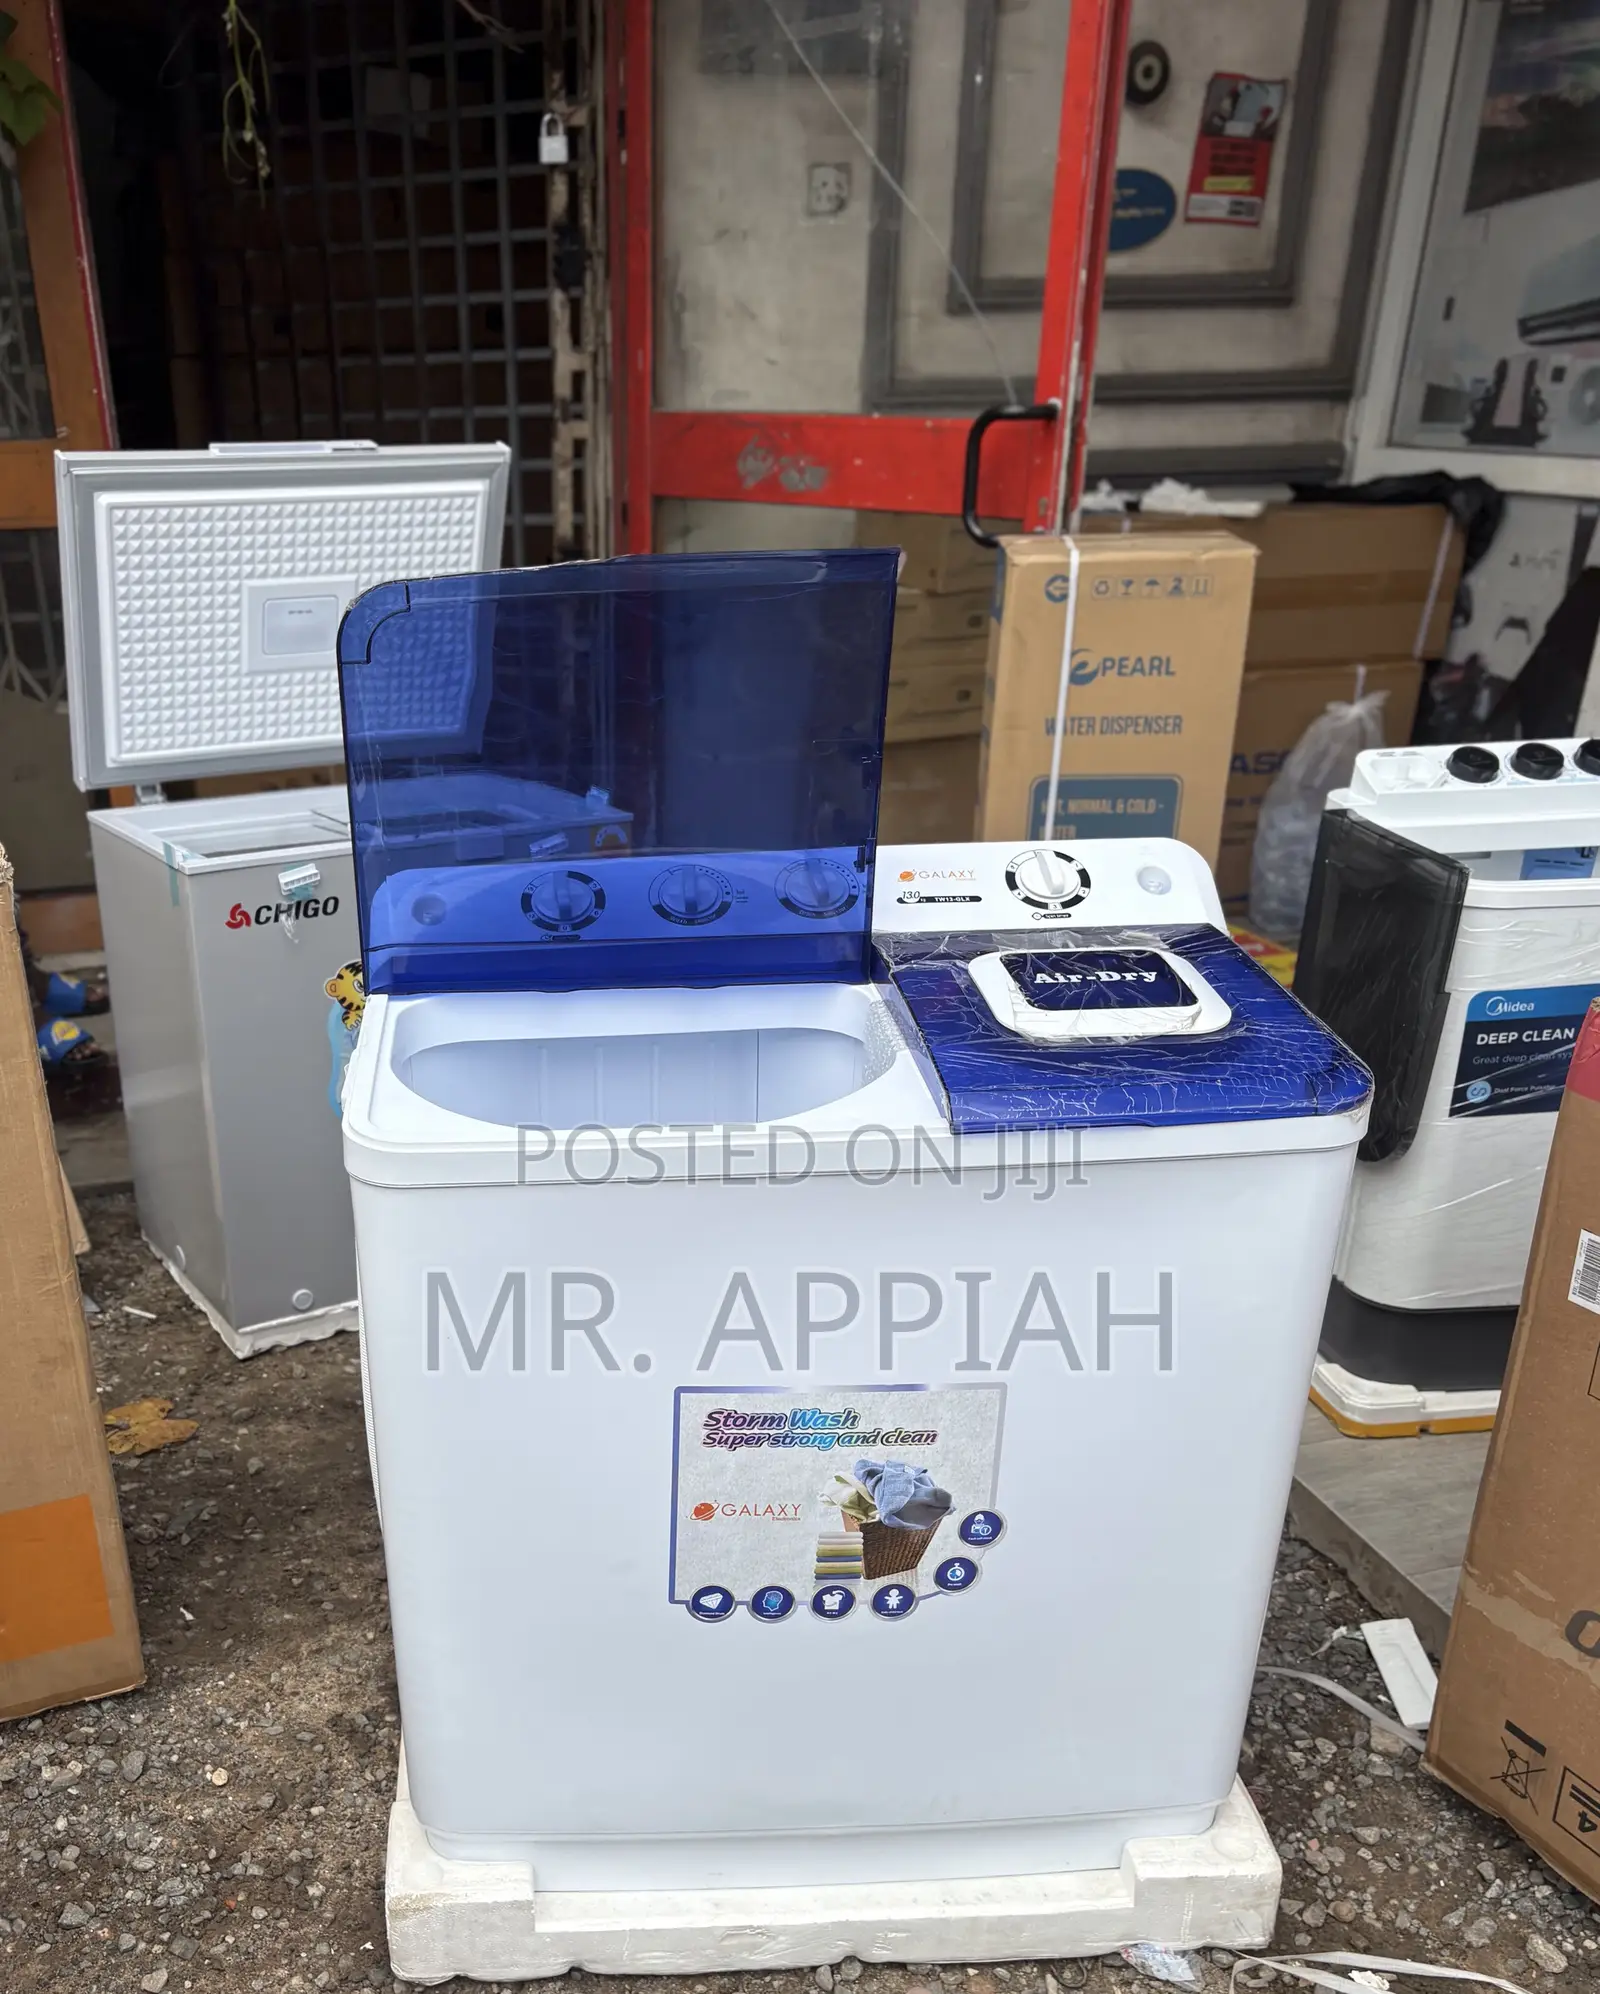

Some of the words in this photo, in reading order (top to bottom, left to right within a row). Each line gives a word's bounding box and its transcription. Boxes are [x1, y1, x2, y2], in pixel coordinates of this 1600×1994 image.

[1101, 656, 1176, 677] PEARL
[1099, 714, 1183, 735] DISPENSER
[918, 869, 975, 880] GALAXY
[902, 890, 921, 900] 13.0
[254, 896, 341, 927] CHIGO
[1034, 971, 1158, 984] Air-Dry
[1487, 997, 1535, 1016] Midea
[1476, 1031, 1519, 1046] DEEP
[1522, 1027, 1575, 1043] CLEAN
[1472, 1055, 1500, 1066] Great
[1502, 1054, 1528, 1064] deep
[703, 1409, 787, 1430] Storm
[788, 1408, 860, 1430] Wash
[702, 1430, 769, 1450] Super
[768, 1431, 838, 1450] strong
[837, 1428, 881, 1447] and
[882, 1427, 938, 1446] clean
[721, 1503, 802, 1517] GALAXY
[1579, 1810, 1598, 1833] 4
